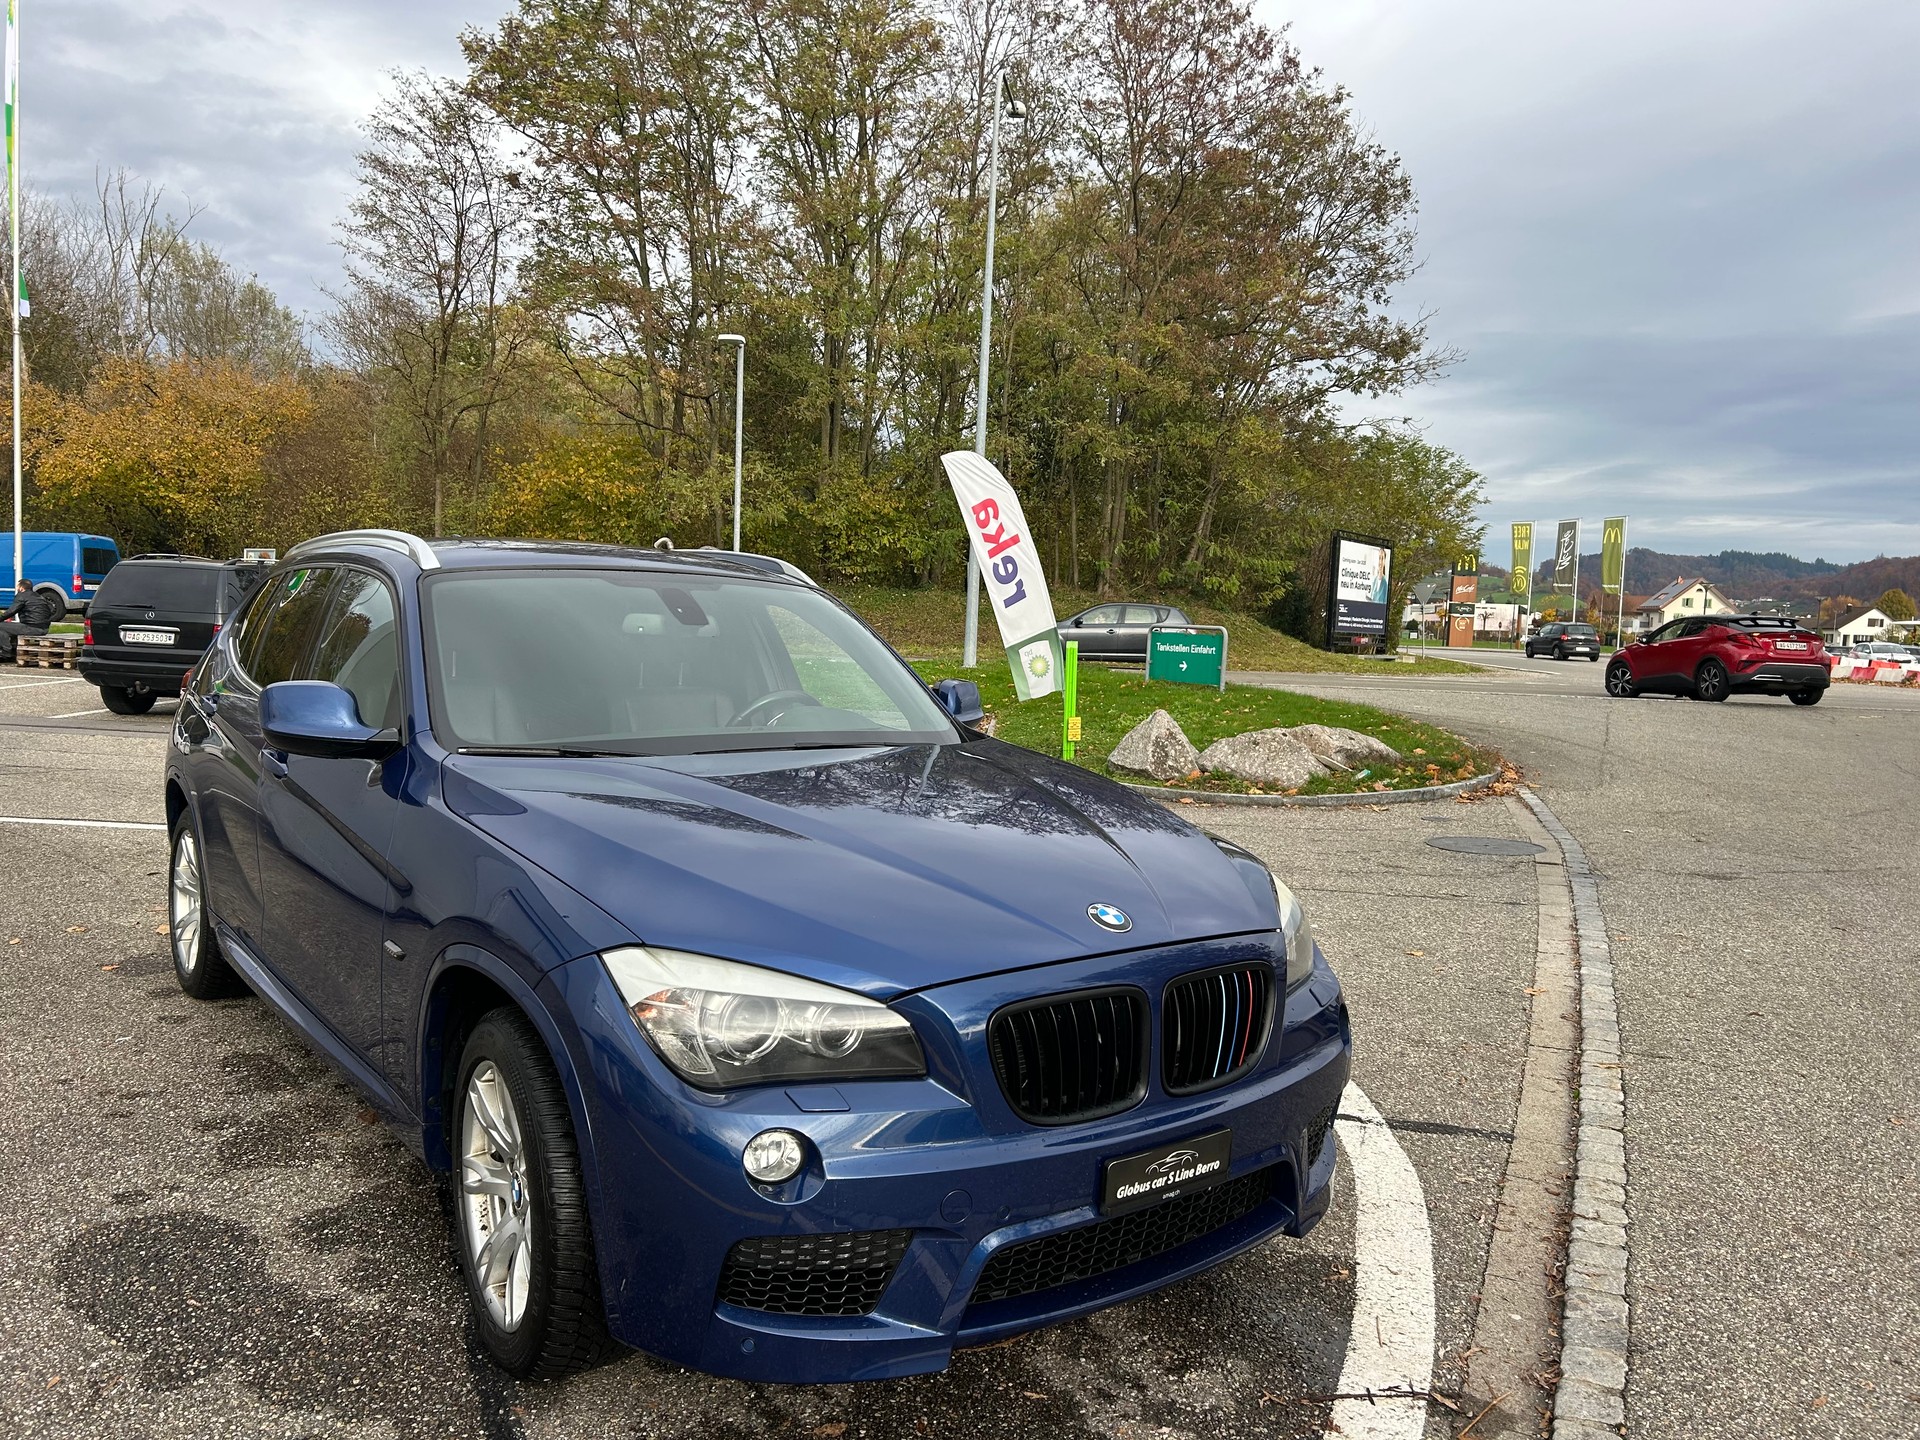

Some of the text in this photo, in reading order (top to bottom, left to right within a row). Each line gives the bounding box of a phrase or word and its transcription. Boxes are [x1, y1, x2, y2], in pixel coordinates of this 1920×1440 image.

[1341, 568, 1371, 581] Clinique DELC
[1355, 581, 1371, 593] Aarburg
[1156, 642, 1216, 654] Tankstellen Einfahrt
[1116, 1160, 1221, 1199] Globus car S Line Berro
